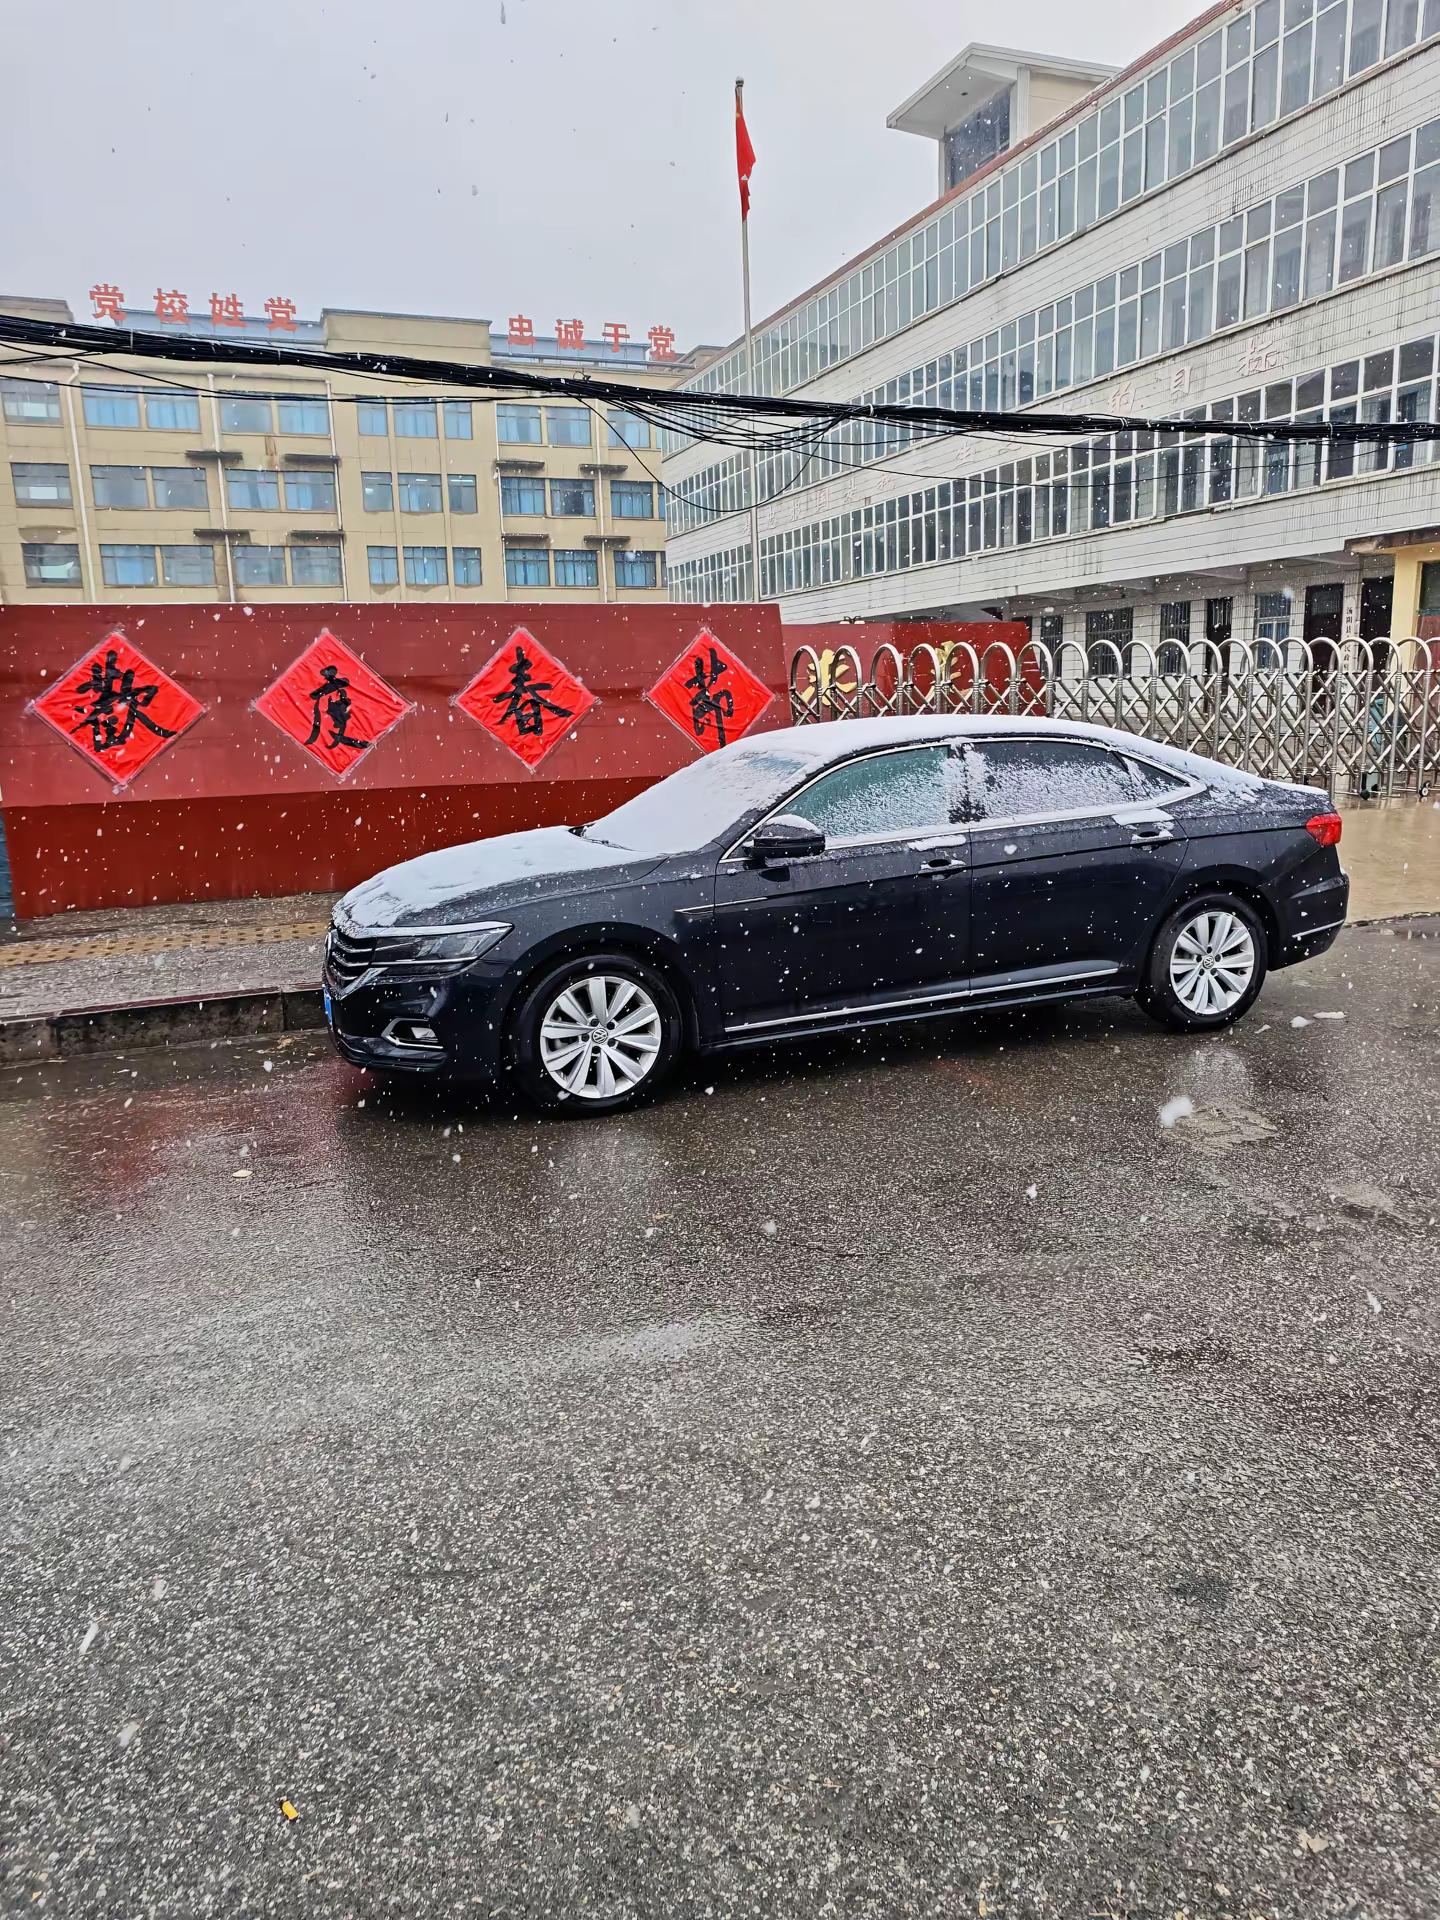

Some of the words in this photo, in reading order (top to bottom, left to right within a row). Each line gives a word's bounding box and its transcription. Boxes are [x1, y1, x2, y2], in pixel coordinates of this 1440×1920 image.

[89, 283, 299, 332] 党校姓党
[507, 314, 678, 362] 忠诚于党
